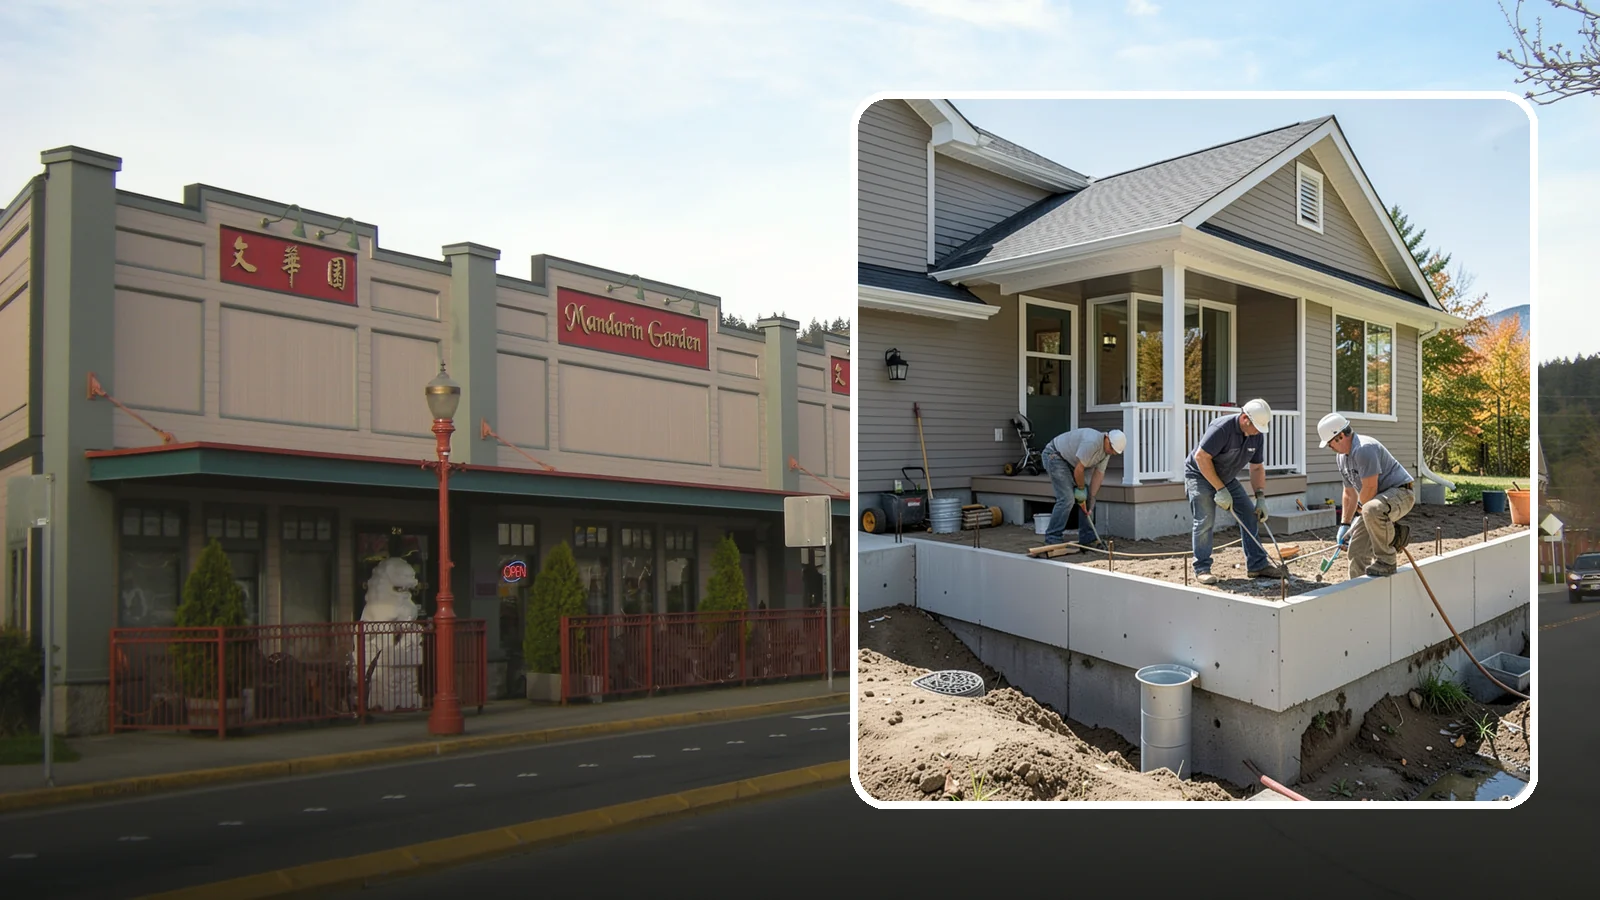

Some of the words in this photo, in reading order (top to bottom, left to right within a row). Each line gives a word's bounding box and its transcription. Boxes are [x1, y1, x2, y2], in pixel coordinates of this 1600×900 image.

[564, 302, 644, 341] Mandarin
[648, 320, 701, 352] Garden
[503, 565, 527, 578] OPEN
